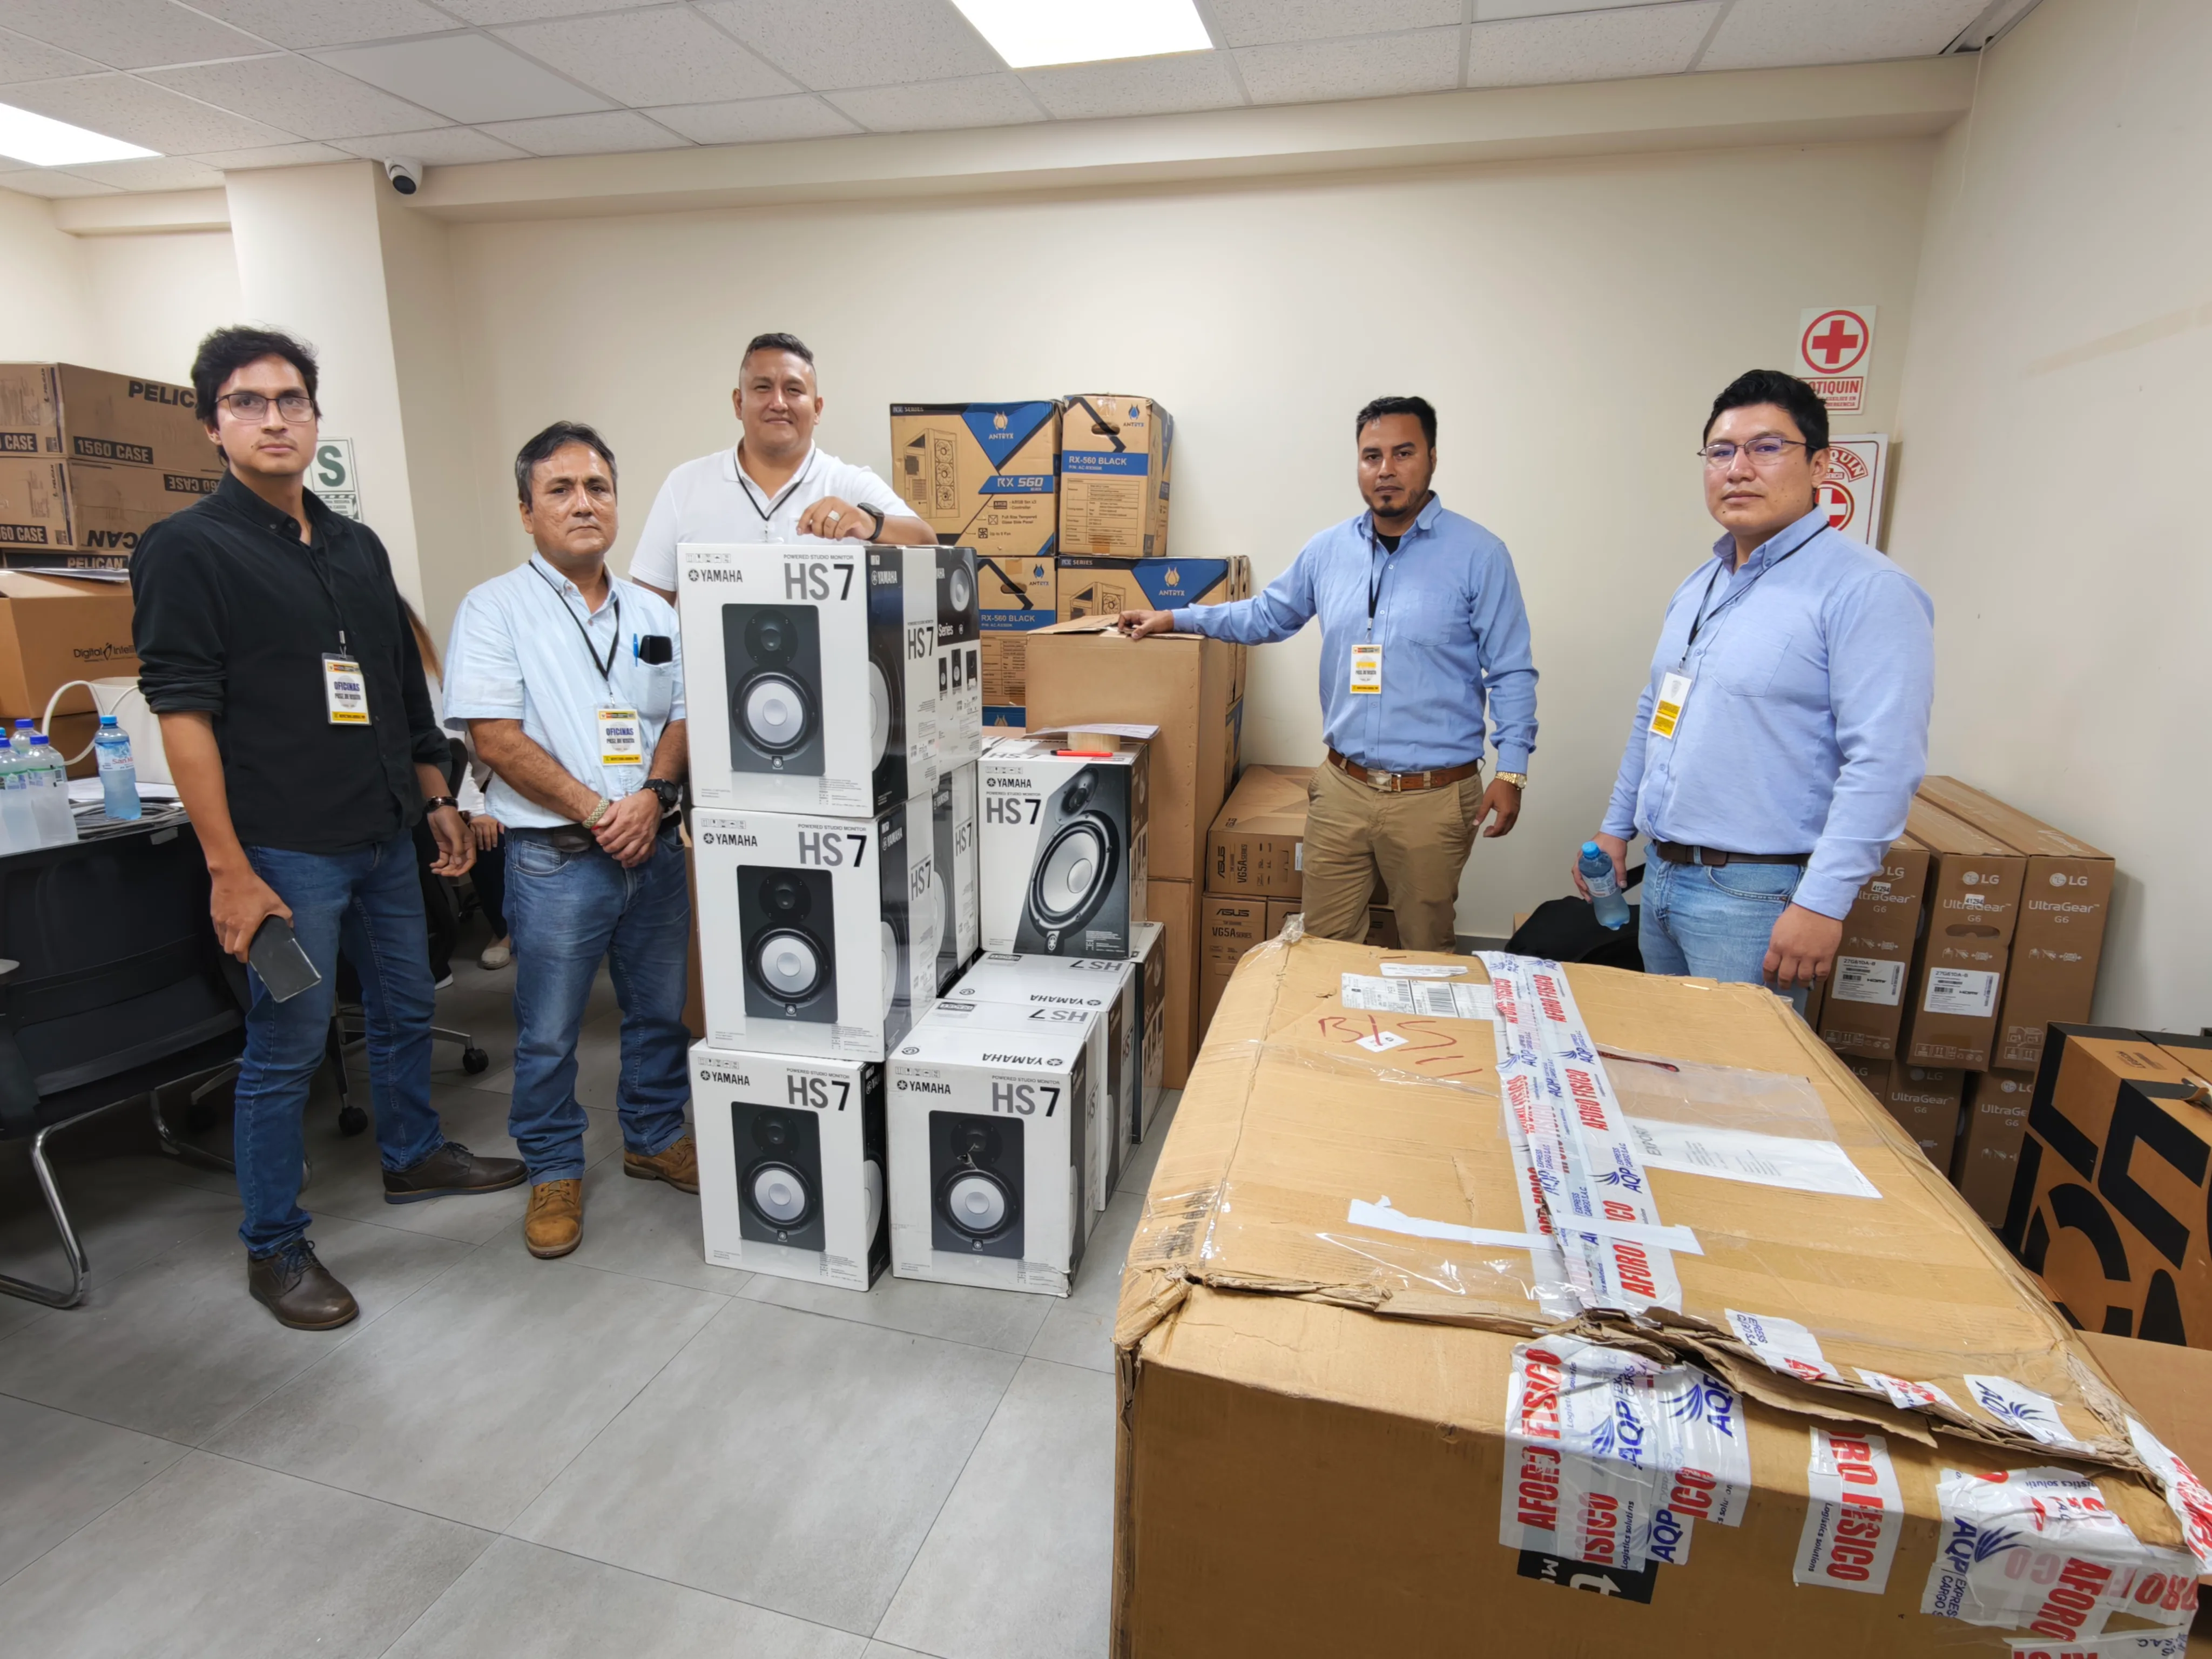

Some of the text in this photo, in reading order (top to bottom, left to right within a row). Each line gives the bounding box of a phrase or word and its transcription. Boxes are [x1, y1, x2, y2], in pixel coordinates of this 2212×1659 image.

[128, 380, 198, 408] PELIC
[5, 435, 35, 450] CASE
[78, 440, 150, 463] 1560 CASE
[317, 446, 346, 487] S
[1069, 456, 1127, 465] RX-560 BLACK
[169, 476, 199, 491] CASE
[17, 528, 45, 542] CASE
[68, 557, 123, 569] PELICAN
[701, 569, 743, 583] YAMAHA
[878, 570, 898, 584] YAMAHA
[73, 648, 103, 659] Digital
[334, 682, 360, 691] OFICINAS
[997, 778, 1032, 788] YAMAHA
[716, 834, 758, 847] YAMAHA
[1887, 867, 1905, 877] LG
[1981, 874, 1999, 884] LG
[2069, 876, 2088, 886] LG
[1859, 889, 1910, 904] ltraGear
[1216, 909, 1250, 917] ASUS
[1030, 995, 1083, 1004] YAMAHA
[1533, 974, 1567, 1023] AFORO FISICO
[982, 1053, 1042, 1066] YAMAHA
[1576, 1047, 1595, 1065] AQP
[712, 1071, 750, 1087] YAMAHA
[1853, 1067, 1868, 1076] LG
[909, 1081, 951, 1095] YAMAHA
[1546, 1078, 1563, 1098] AQP
[1565, 1069, 1609, 1131] AFORO FISICO
[1981, 1104, 2028, 1116] UltraGe
[1633, 1125, 1663, 1156] EXPORT
[1535, 1149, 1543, 1168] EXPRESS
[1612, 1147, 1622, 1165] EXPRESS
[1619, 1168, 1643, 1195] AQP
[1572, 1192, 1582, 1214] EXPRESS
[1613, 1244, 1656, 1299] AFORO
[1522, 1348, 1563, 1439] FISICO
[1616, 1401, 1645, 1471] AQP
[2026, 1480, 2059, 1489] soluti
[1575, 1492, 1619, 1564] ISICO
[1621, 1501, 1635, 1569] Logistics solutins
[1651, 1509, 1684, 1564] AQP
[1808, 1502, 1834, 1572] Logistics solutions
[1945, 1516, 1977, 1576] AQP
[1935, 1574, 1953, 1609] CARGO
[1947, 1577, 1966, 1617] EXPRES
[2029, 1557, 2113, 1642] AFORO
